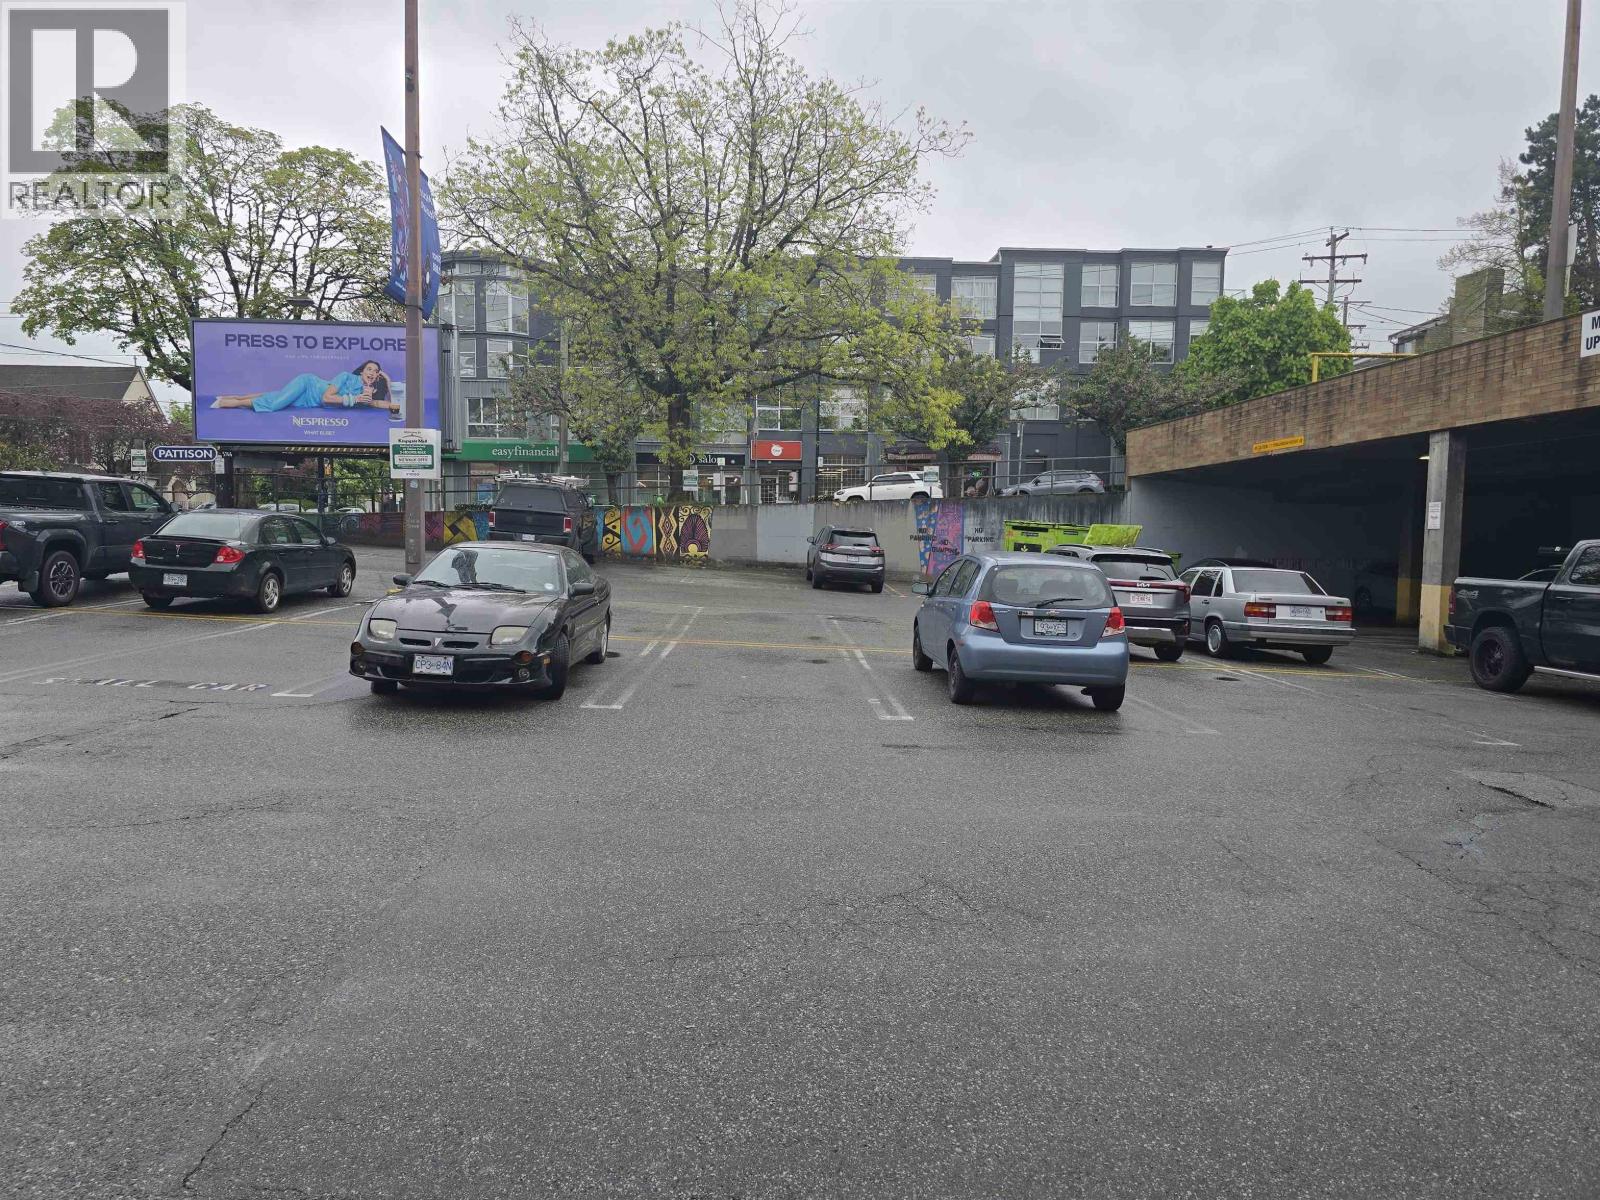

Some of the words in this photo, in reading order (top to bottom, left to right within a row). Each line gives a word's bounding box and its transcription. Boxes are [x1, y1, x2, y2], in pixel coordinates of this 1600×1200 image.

[224, 333, 288, 348] PRESS
[293, 335, 318, 349] TO
[322, 336, 407, 351] EXPLORE
[292, 415, 349, 427] NESPRESSO
[158, 449, 213, 459] PATTISON
[492, 444, 558, 459] easyfinancial
